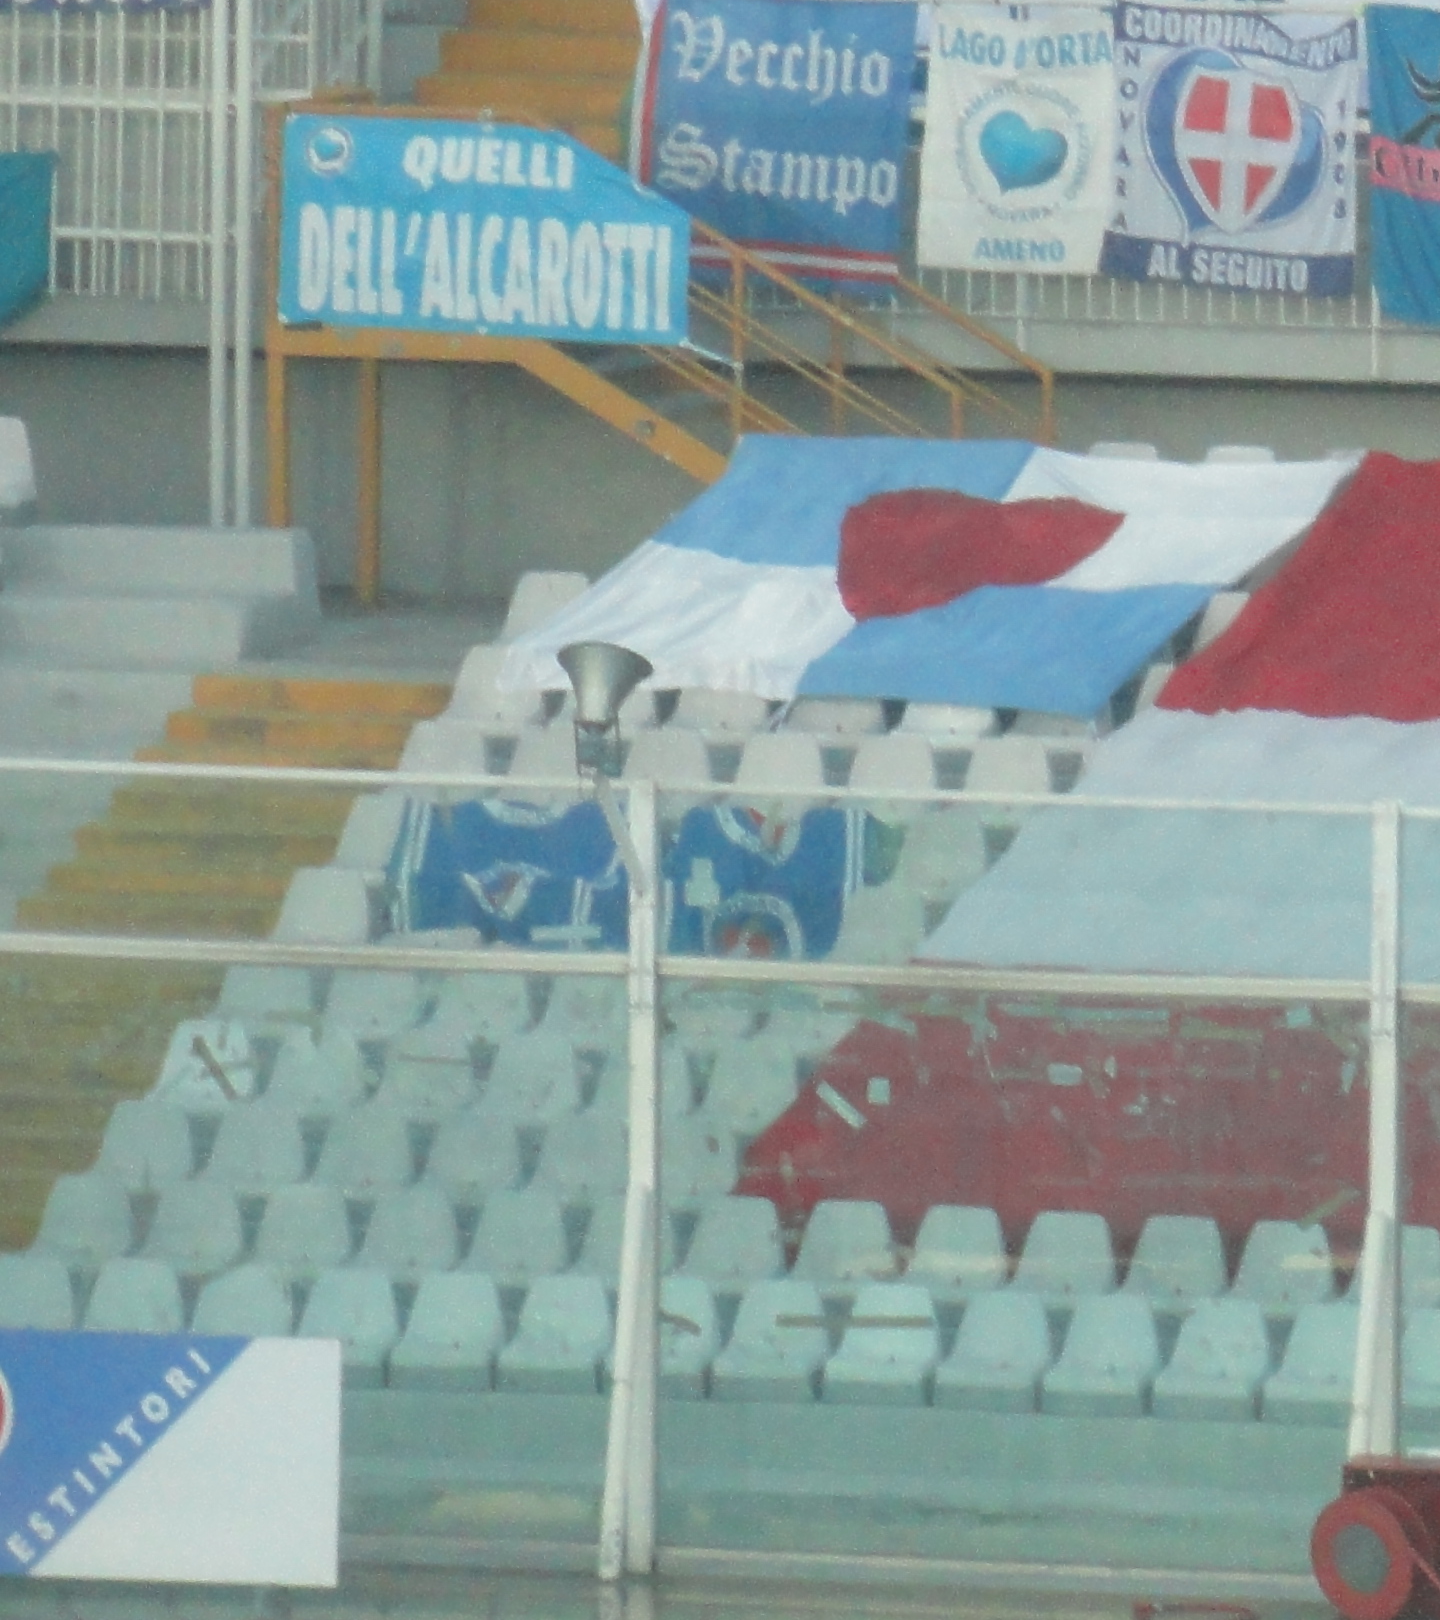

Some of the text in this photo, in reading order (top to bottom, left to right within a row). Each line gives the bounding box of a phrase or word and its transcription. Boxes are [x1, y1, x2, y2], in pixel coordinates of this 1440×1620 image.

[671, 9, 891, 106] Vecchio
[938, 23, 1007, 67] LAGO
[403, 135, 574, 189] QUELLI
[656, 122, 897, 216] Stampo
[299, 203, 673, 332] DELL'ALCAROTTI
[974, 236, 1066, 263] AMENO
[1146, 243, 1308, 291] AL SEGUITO
[6, 1348, 212, 1564] ESTINTORI
